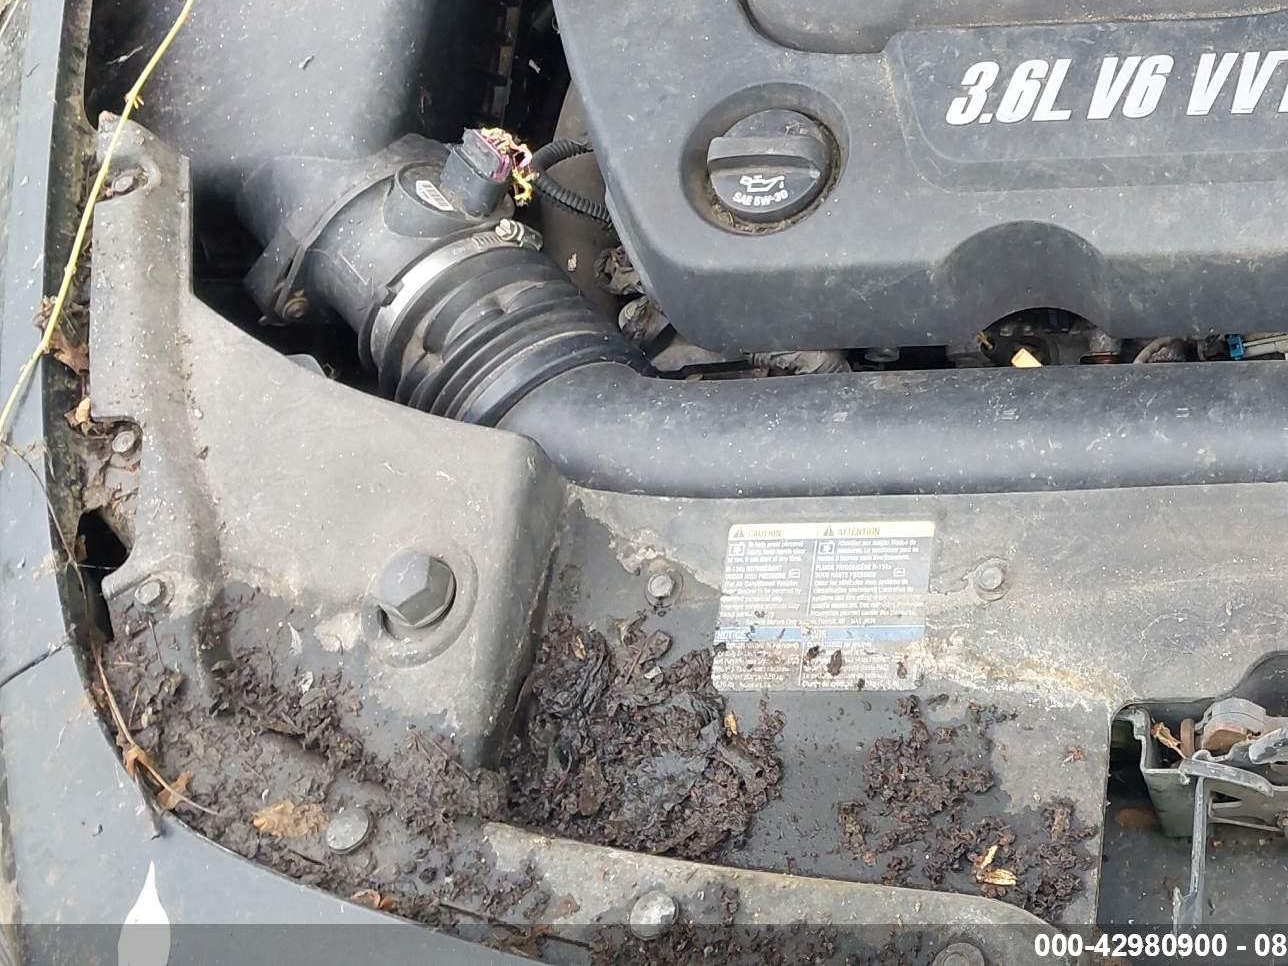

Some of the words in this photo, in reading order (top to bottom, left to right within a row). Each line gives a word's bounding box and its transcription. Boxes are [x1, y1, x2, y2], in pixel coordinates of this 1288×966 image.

[944, 58, 1073, 126] 3.6L
[1086, 54, 1175, 121] V6
[732, 191, 753, 206] SAE
[753, 189, 789, 207] 5W-30
